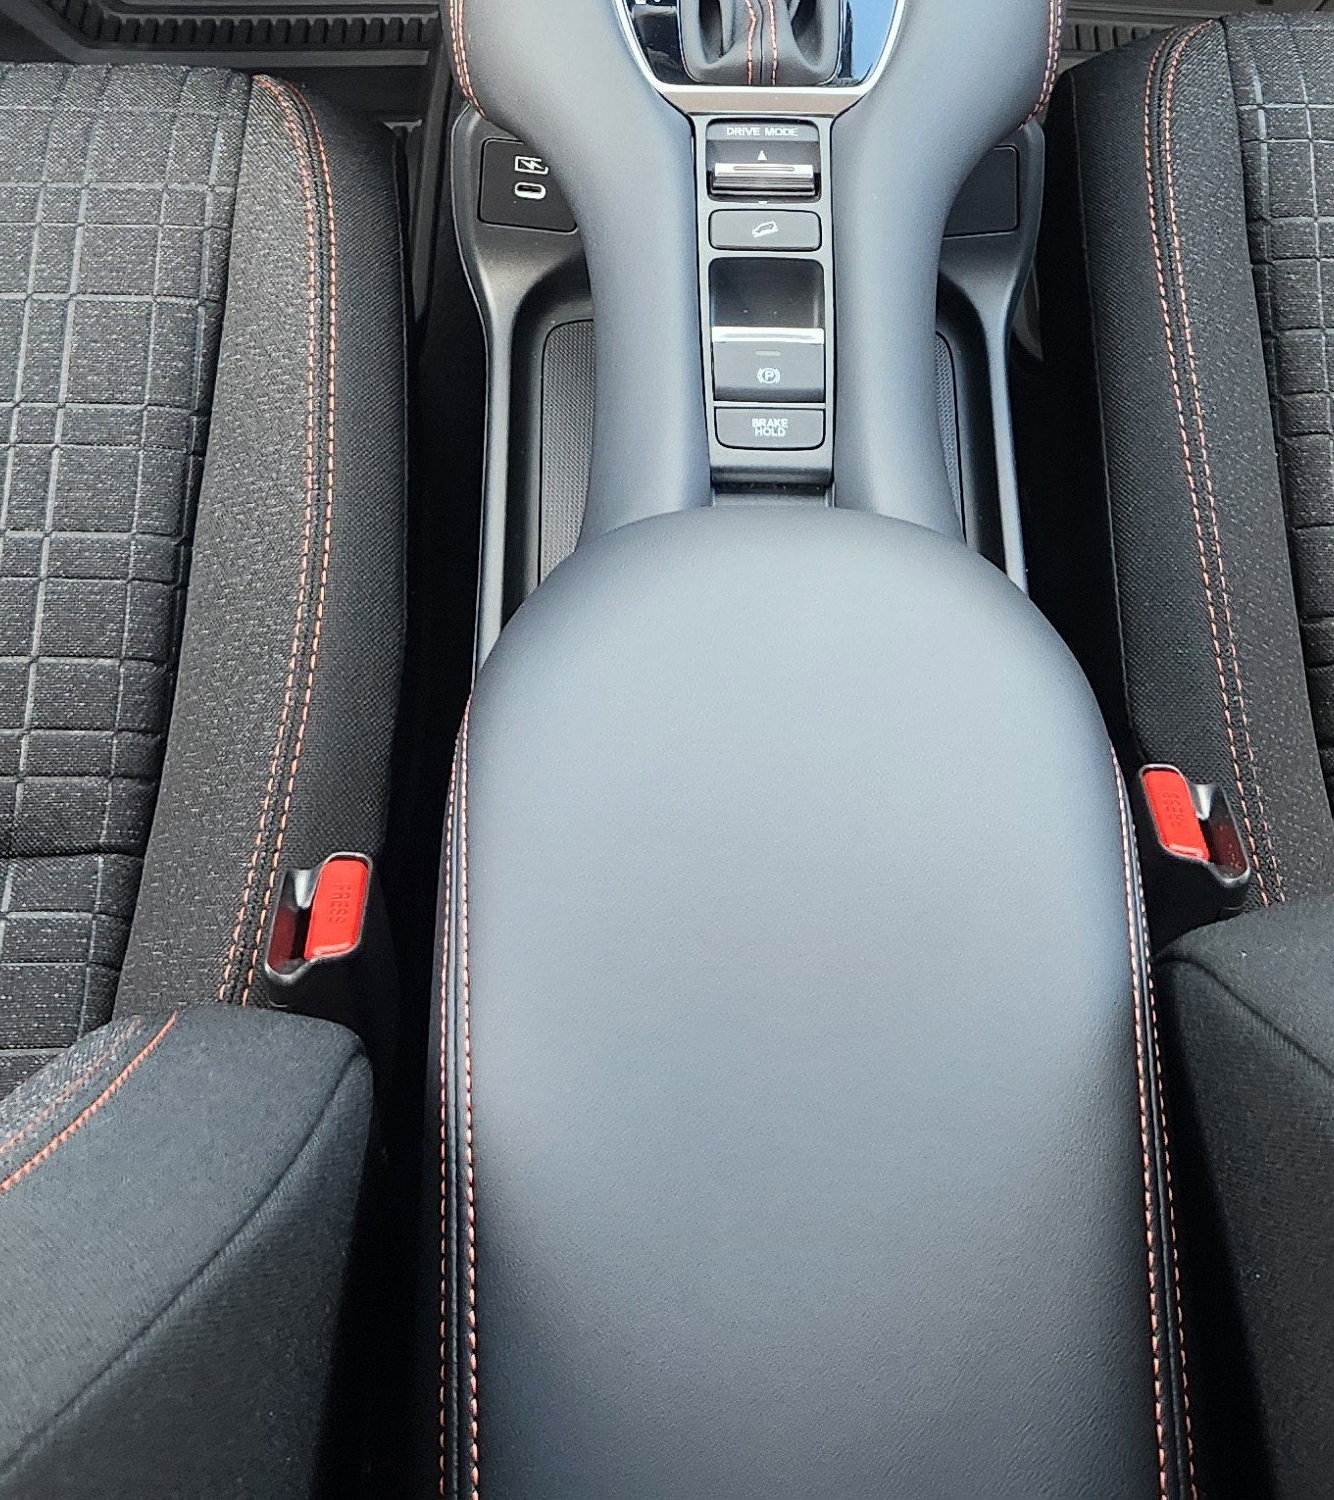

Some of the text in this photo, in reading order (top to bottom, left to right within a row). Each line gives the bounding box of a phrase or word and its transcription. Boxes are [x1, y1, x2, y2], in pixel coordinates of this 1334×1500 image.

[726, 127, 799, 137] DRIVE MODE
[751, 418, 789, 429] BRAKE
[754, 427, 786, 438] HOLD
[328, 883, 351, 924] PRESS
